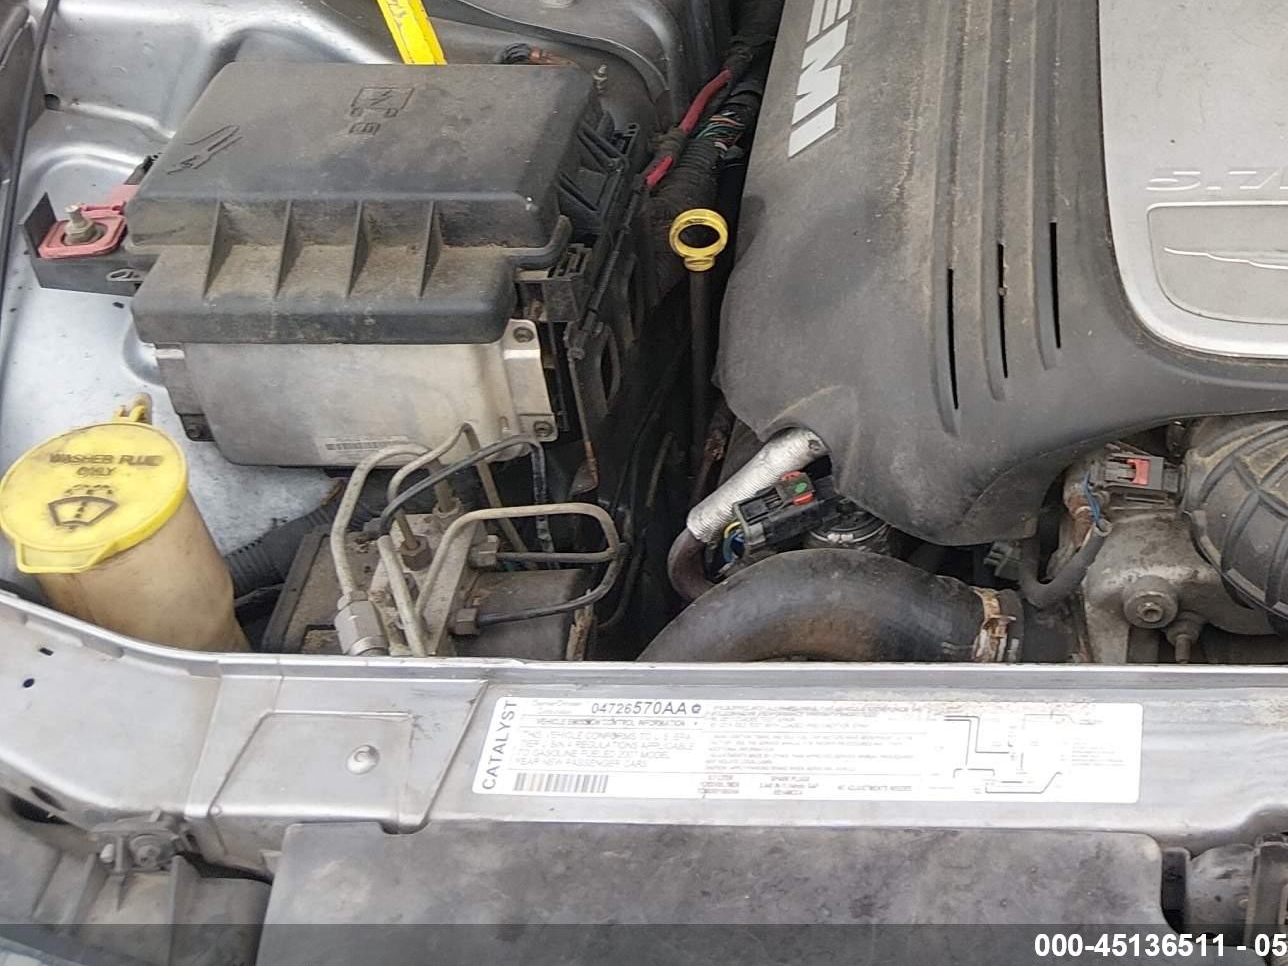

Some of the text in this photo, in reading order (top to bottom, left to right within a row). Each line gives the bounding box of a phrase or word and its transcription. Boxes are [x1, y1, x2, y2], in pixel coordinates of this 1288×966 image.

[50, 454, 114, 466] WASHER
[77, 466, 117, 477] ONLY
[591, 700, 688, 715] 04726570AA
[481, 700, 518, 791] CATALYST
